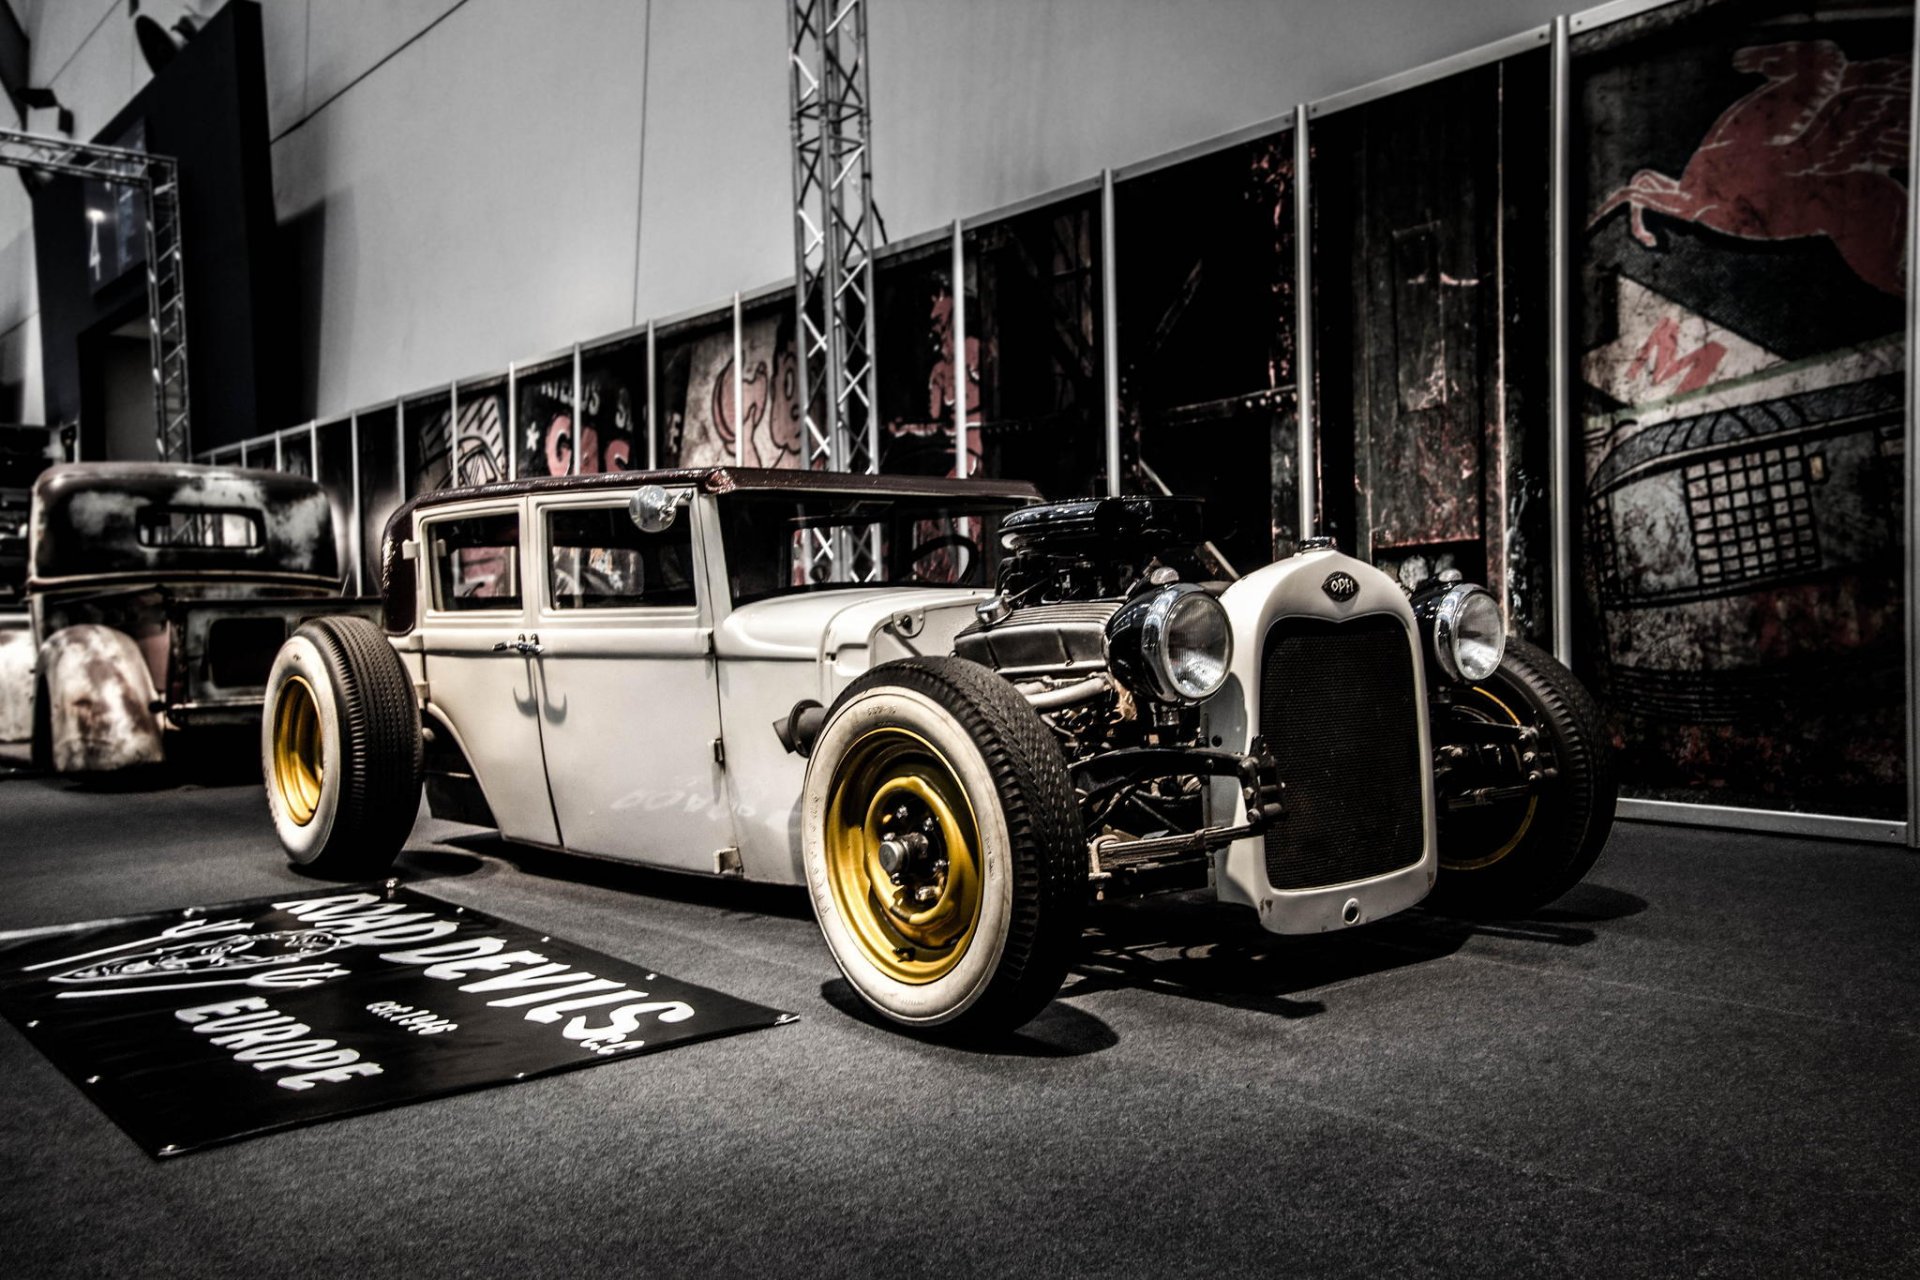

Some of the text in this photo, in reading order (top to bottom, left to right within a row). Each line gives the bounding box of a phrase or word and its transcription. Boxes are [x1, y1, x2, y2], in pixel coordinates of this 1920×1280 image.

[272, 893, 460, 946] ROAD
[379, 936, 696, 1039] DEVILS
[175, 996, 384, 1090] EUROPE
